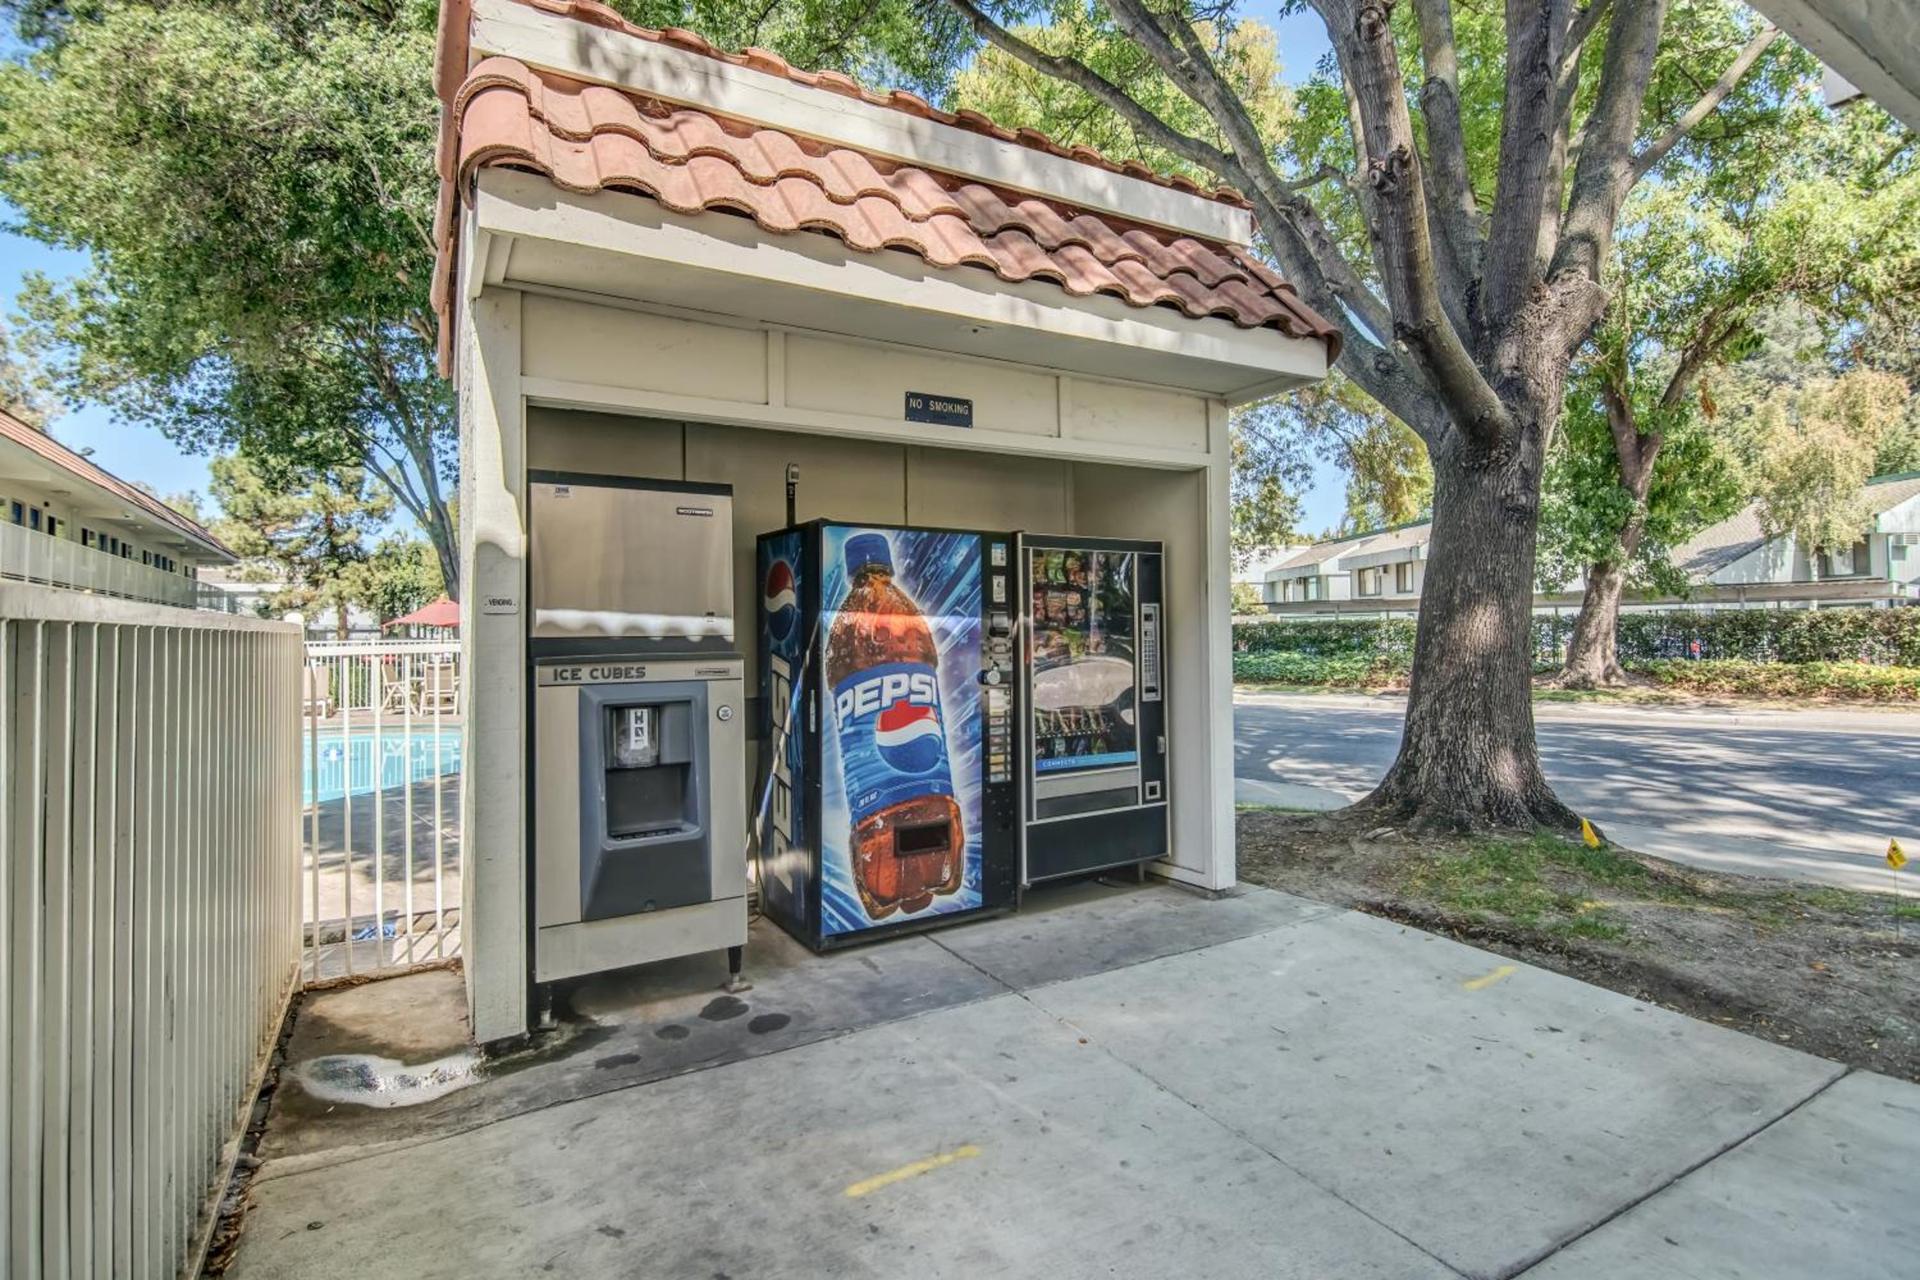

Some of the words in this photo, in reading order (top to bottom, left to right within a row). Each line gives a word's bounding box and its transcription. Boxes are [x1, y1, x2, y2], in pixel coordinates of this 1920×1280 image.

[909, 398, 923, 409] NO
[929, 400, 969, 415] SMOKING
[553, 668, 582, 681] ICE
[590, 666, 646, 680] CUBES
[836, 672, 938, 731] PEPSI
